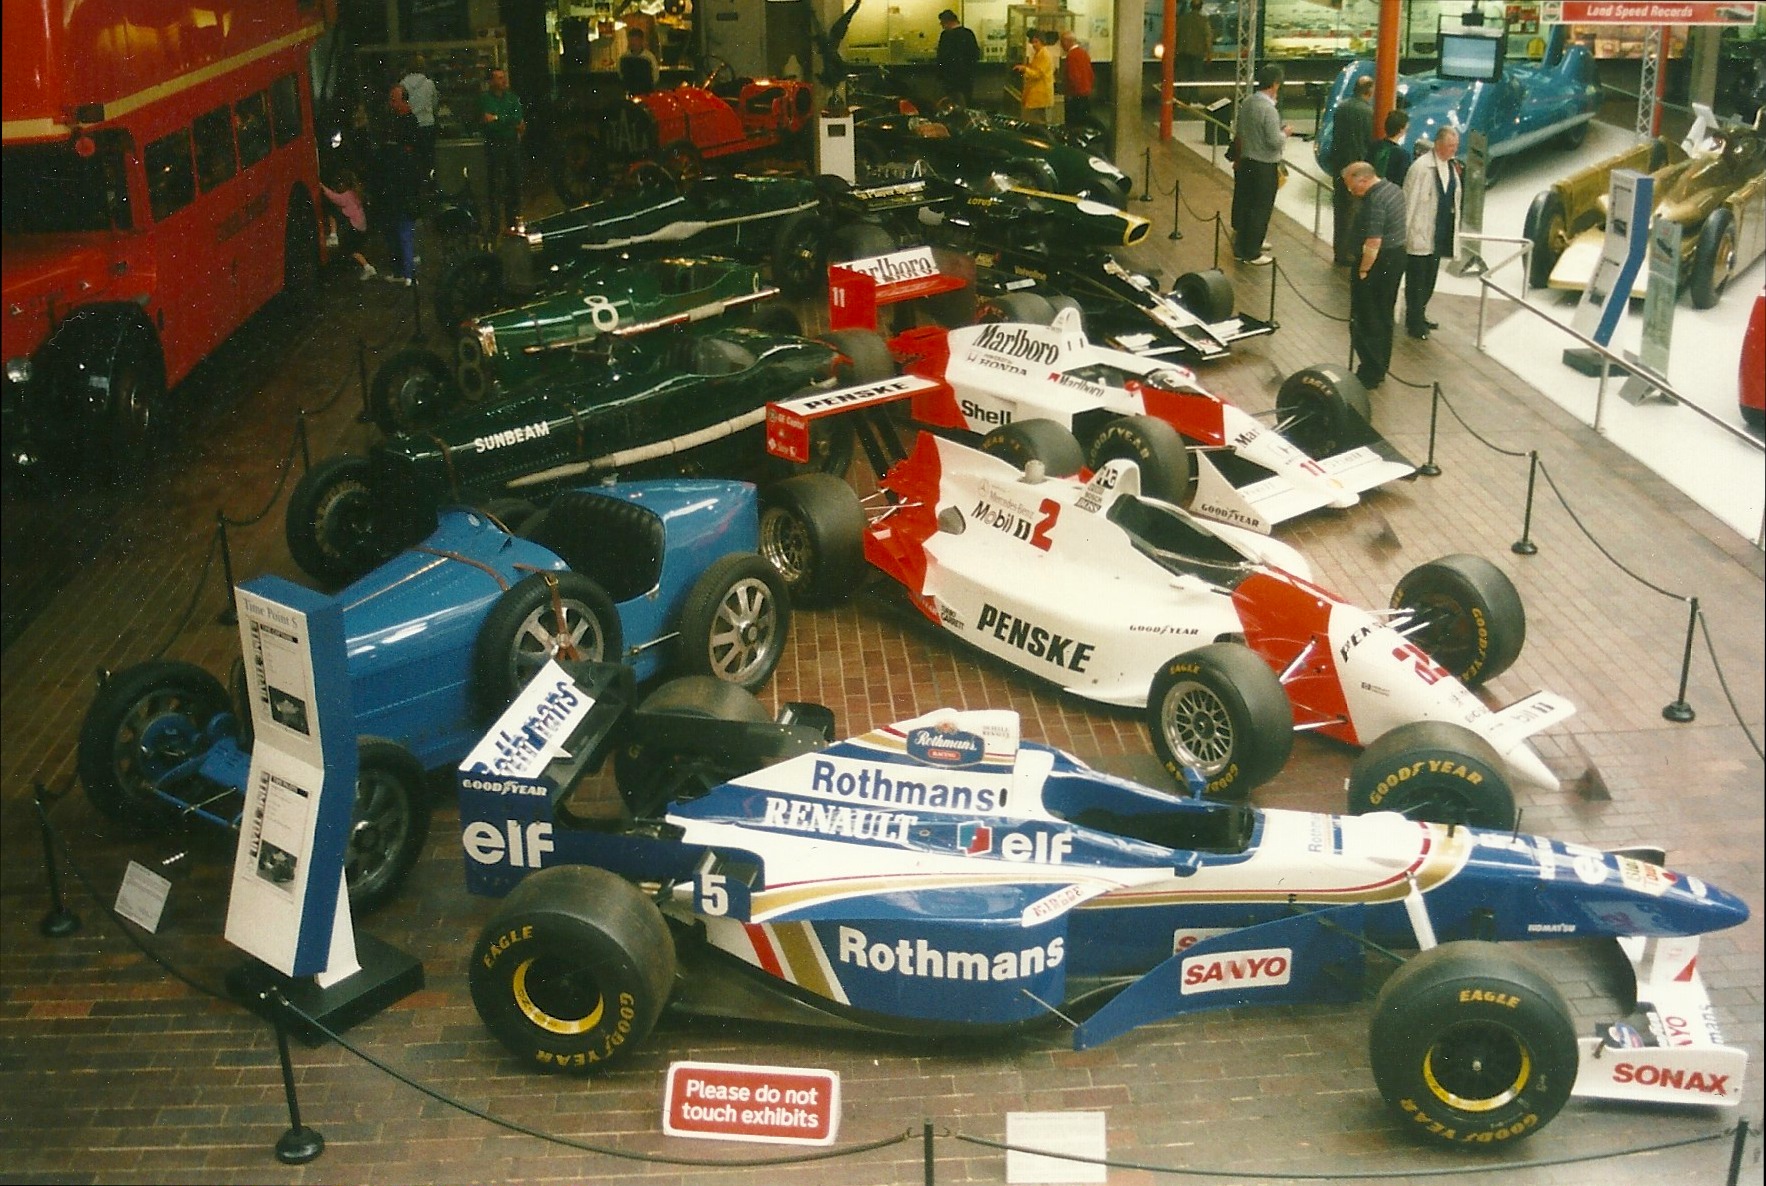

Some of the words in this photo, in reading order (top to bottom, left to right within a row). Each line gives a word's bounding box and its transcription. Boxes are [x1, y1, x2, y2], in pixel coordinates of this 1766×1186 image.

[1586, 4, 1612, 17] Land
[1615, 4, 1648, 19] Speed
[1650, 5, 1693, 18] Records
[583, 295, 620, 332] 8
[832, 286, 845, 308] 11
[972, 324, 1060, 366] Marlboro
[978, 358, 1028, 377] HONDA
[803, 382, 909, 410] PENSKE
[1057, 374, 1105, 398] Marlboro
[961, 399, 1013, 425] Shell
[474, 420, 550, 454] SUNBEAM
[970, 501, 1014, 533] Mobil
[1014, 518, 1032, 541] 1
[1029, 498, 1061, 552] 2
[244, 597, 266, 616] Time
[267, 606, 290, 625] Point
[977, 603, 1095, 674] PENSKE
[1170, 663, 1201, 675] EAGLE
[811, 760, 995, 812] Rothmans
[756, 797, 919, 846] RENAULT
[462, 819, 555, 868] elf
[1001, 831, 1073, 865] elf
[701, 874, 730, 916] 5
[483, 925, 534, 969] EAGLE
[839, 925, 1065, 981] Rothmans
[1184, 956, 1287, 986] SANYO
[1458, 989, 1521, 1009] EAGLE
[686, 1079, 751, 1102] Please
[755, 1084, 781, 1103] do
[785, 1087, 819, 1106] not
[1612, 1062, 1730, 1096] SONAX
[682, 1102, 737, 1123] touch
[741, 1106, 819, 1129] exhibits
